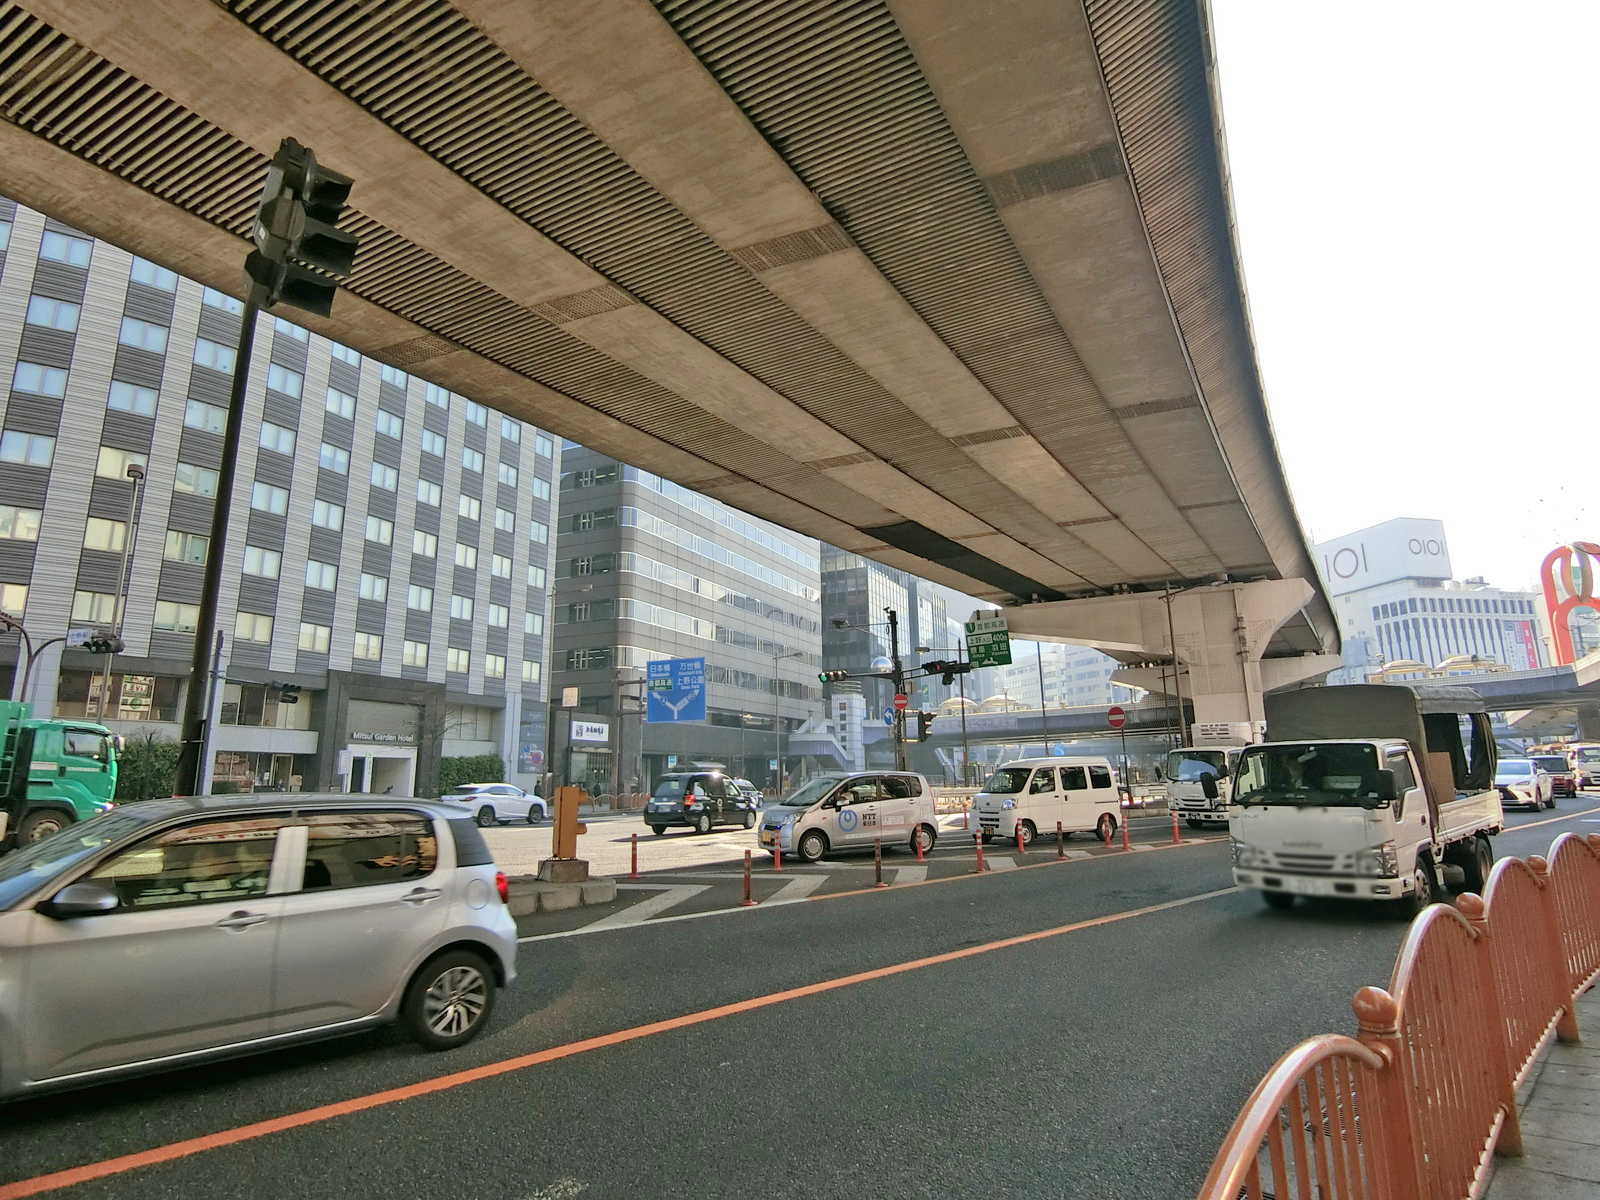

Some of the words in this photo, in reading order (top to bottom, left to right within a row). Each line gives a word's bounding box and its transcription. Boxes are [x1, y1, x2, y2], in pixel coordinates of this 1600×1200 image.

[977, 620, 1005, 630] 首都高速
[969, 636, 992, 645] 上野入口
[992, 633, 1008, 642] 400m
[650, 664, 671, 672] 日本橋
[680, 661, 701, 671] 万世橋
[649, 679, 672, 687] 首都高速
[677, 675, 704, 685] 上野公園
[352, 732, 374, 740] Mitsui
[374, 733, 397, 741] Garden
[397, 734, 414, 742] Hotel
